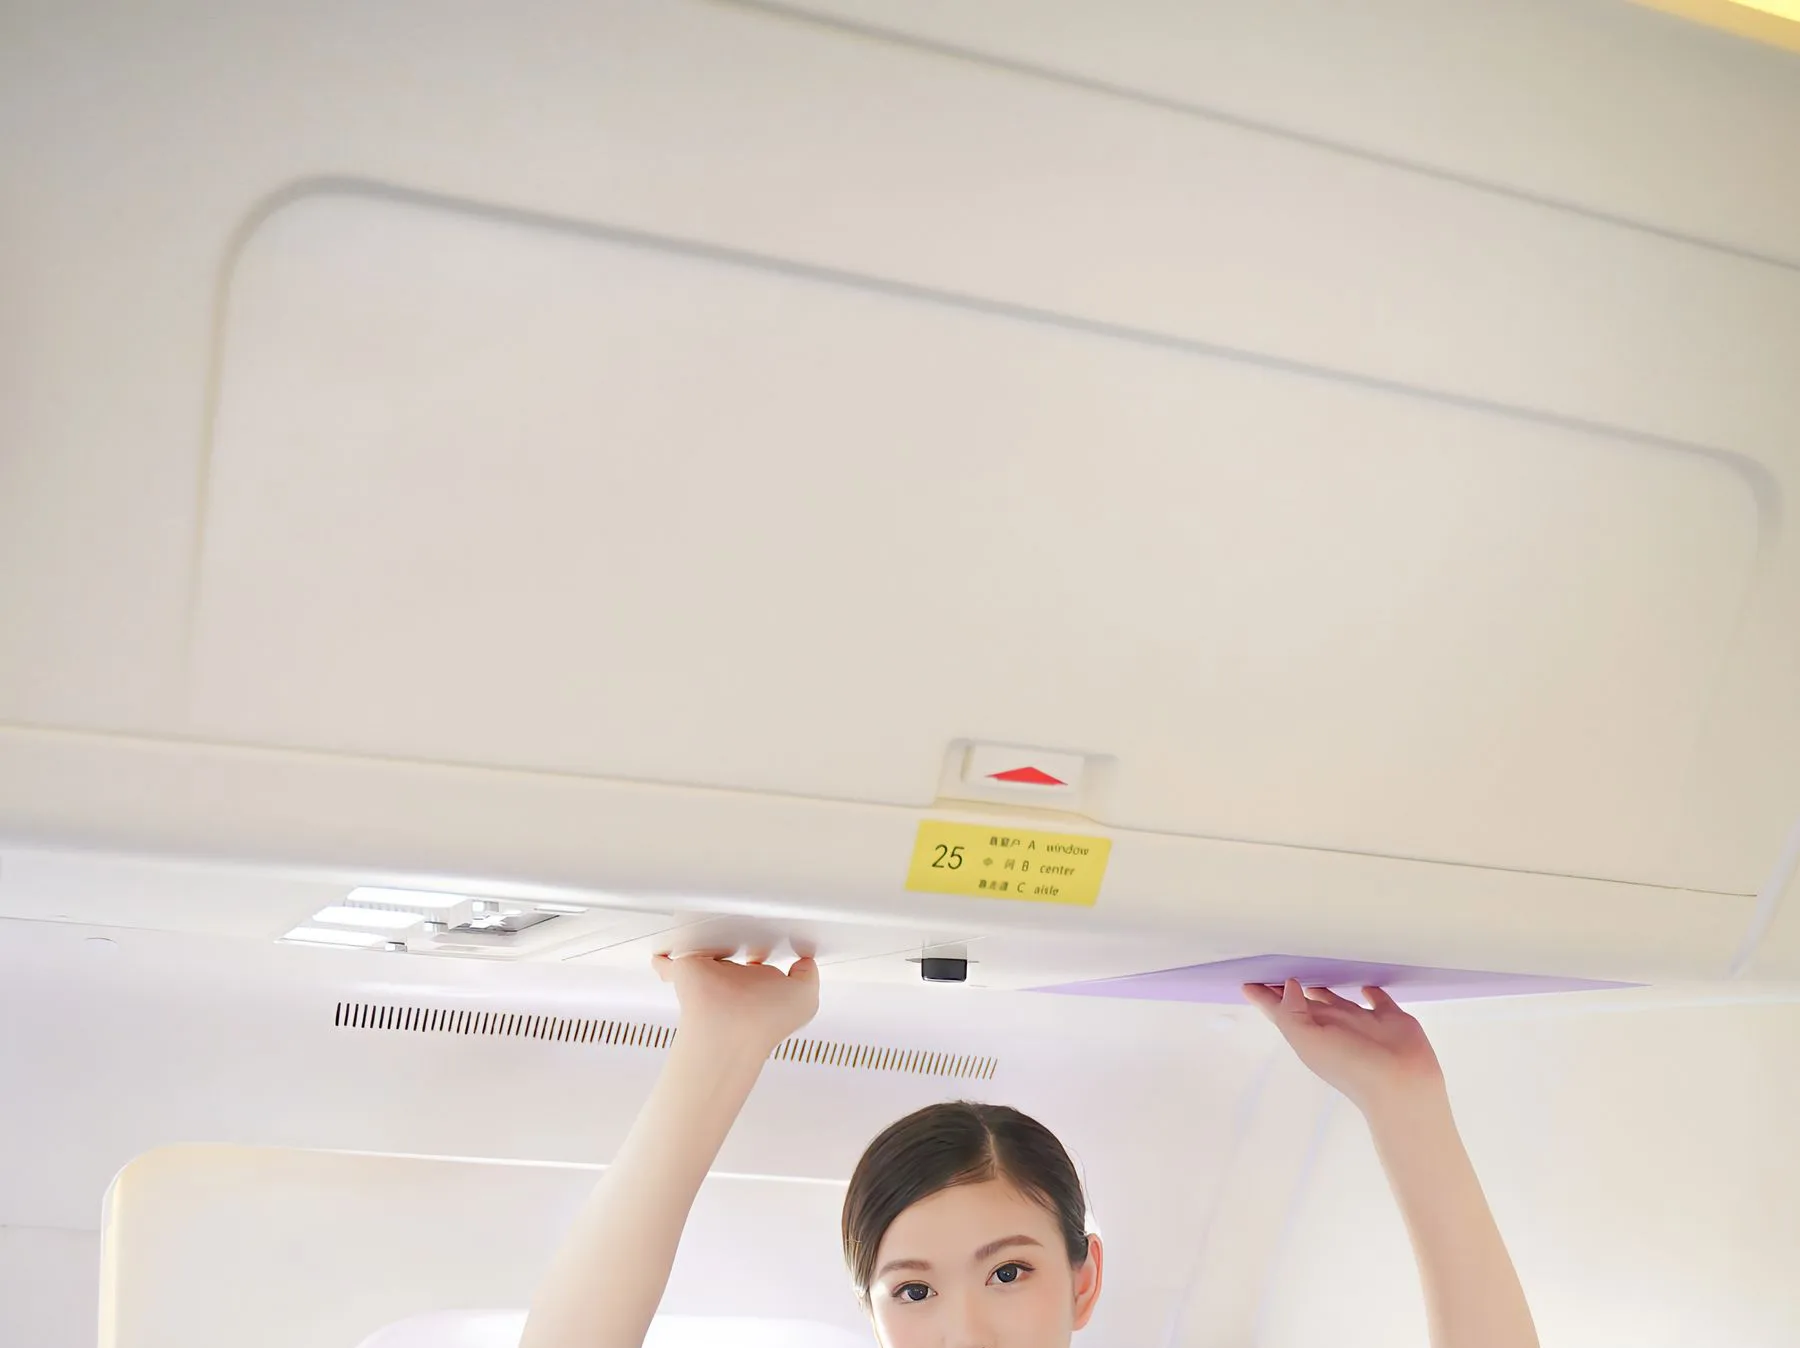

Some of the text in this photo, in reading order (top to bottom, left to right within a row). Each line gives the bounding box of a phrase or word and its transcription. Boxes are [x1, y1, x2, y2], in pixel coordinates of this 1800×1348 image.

[1028, 840, 1036, 851] A
[1046, 844, 1090, 857] window
[931, 844, 965, 871] 25
[1021, 859, 1030, 873] B
[1039, 865, 1076, 877] center
[1016, 881, 1027, 894] C
[1033, 884, 1060, 897] aisle
